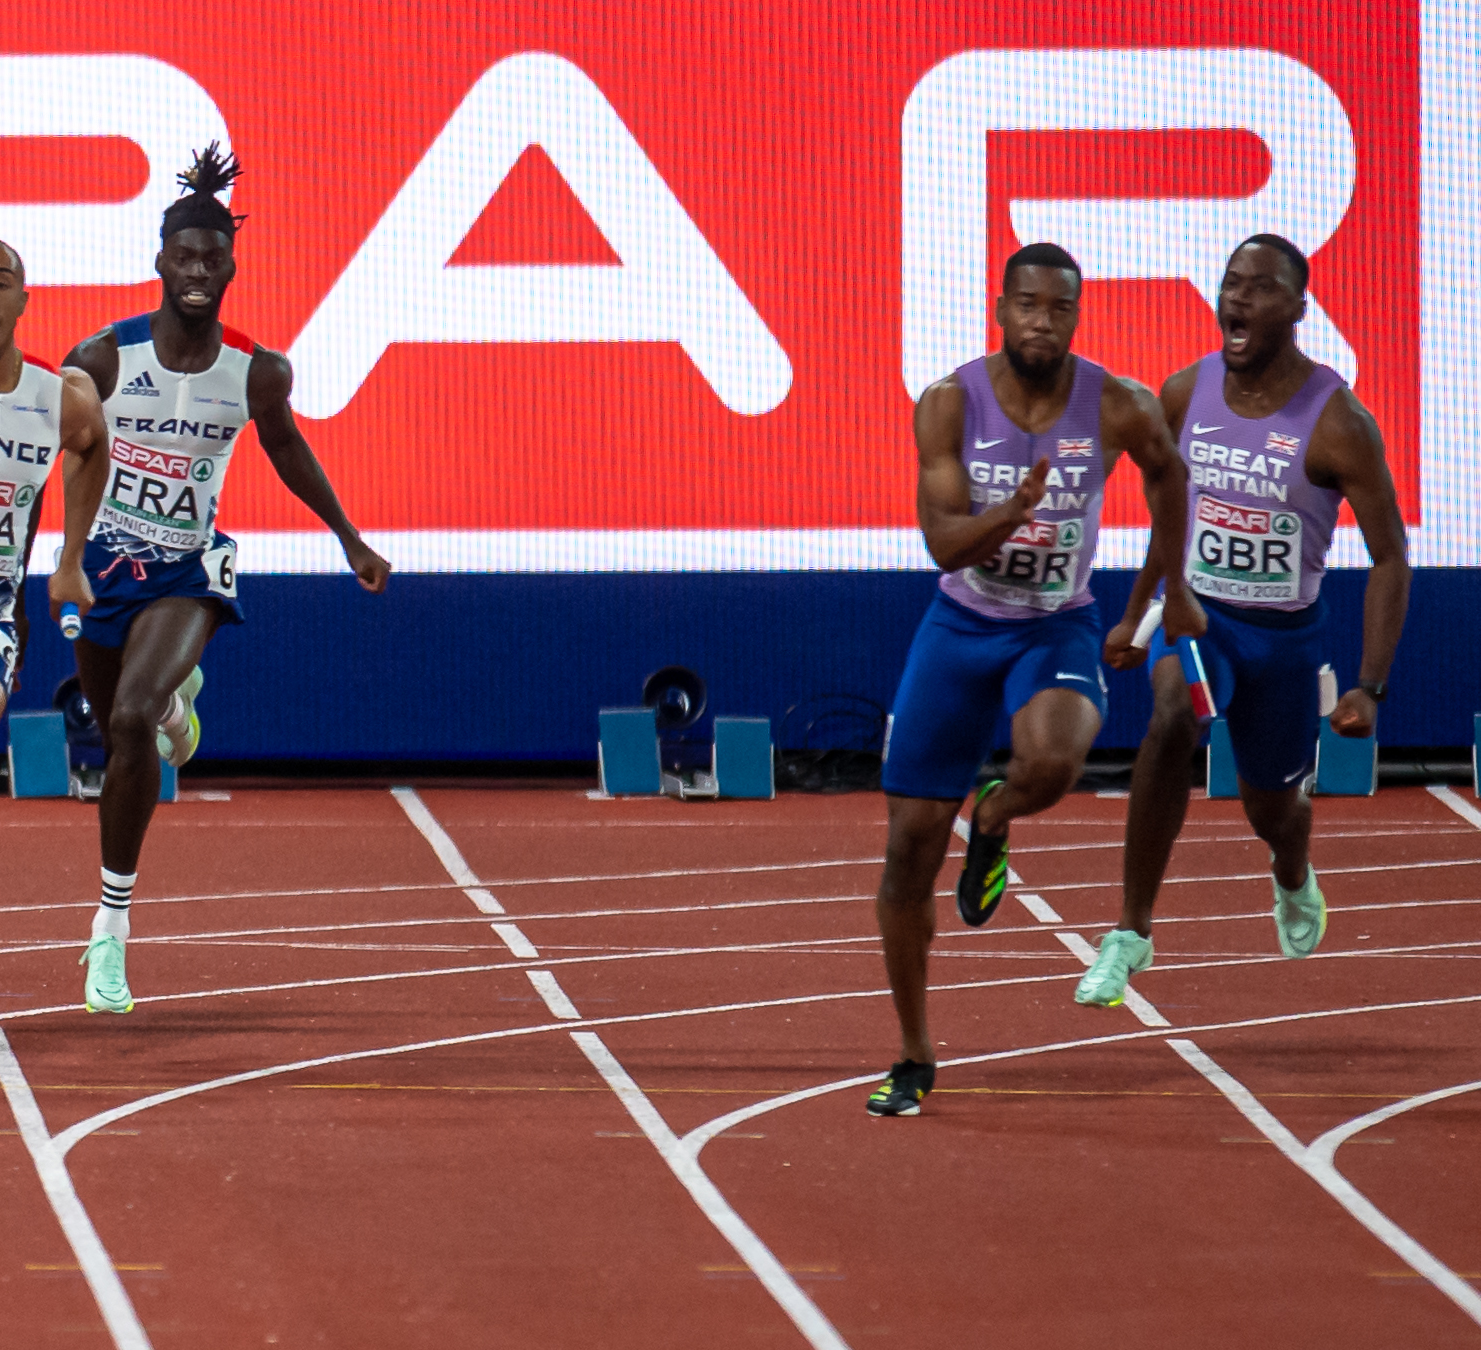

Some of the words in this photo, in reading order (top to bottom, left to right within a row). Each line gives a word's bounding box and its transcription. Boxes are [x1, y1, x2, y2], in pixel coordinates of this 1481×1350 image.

[115, 416, 237, 440] FRANCE
[113, 441, 189, 476] SPAR
[1189, 440, 1290, 479] GREAT
[111, 467, 198, 520] FRA
[1191, 465, 1287, 502] BRITAIN
[103, 507, 157, 538] MUNICH
[161, 530, 197, 546] 2022
[1199, 501, 1268, 531] SPAR
[1198, 530, 1291, 573] GBR
[220, 555, 233, 589] 6
